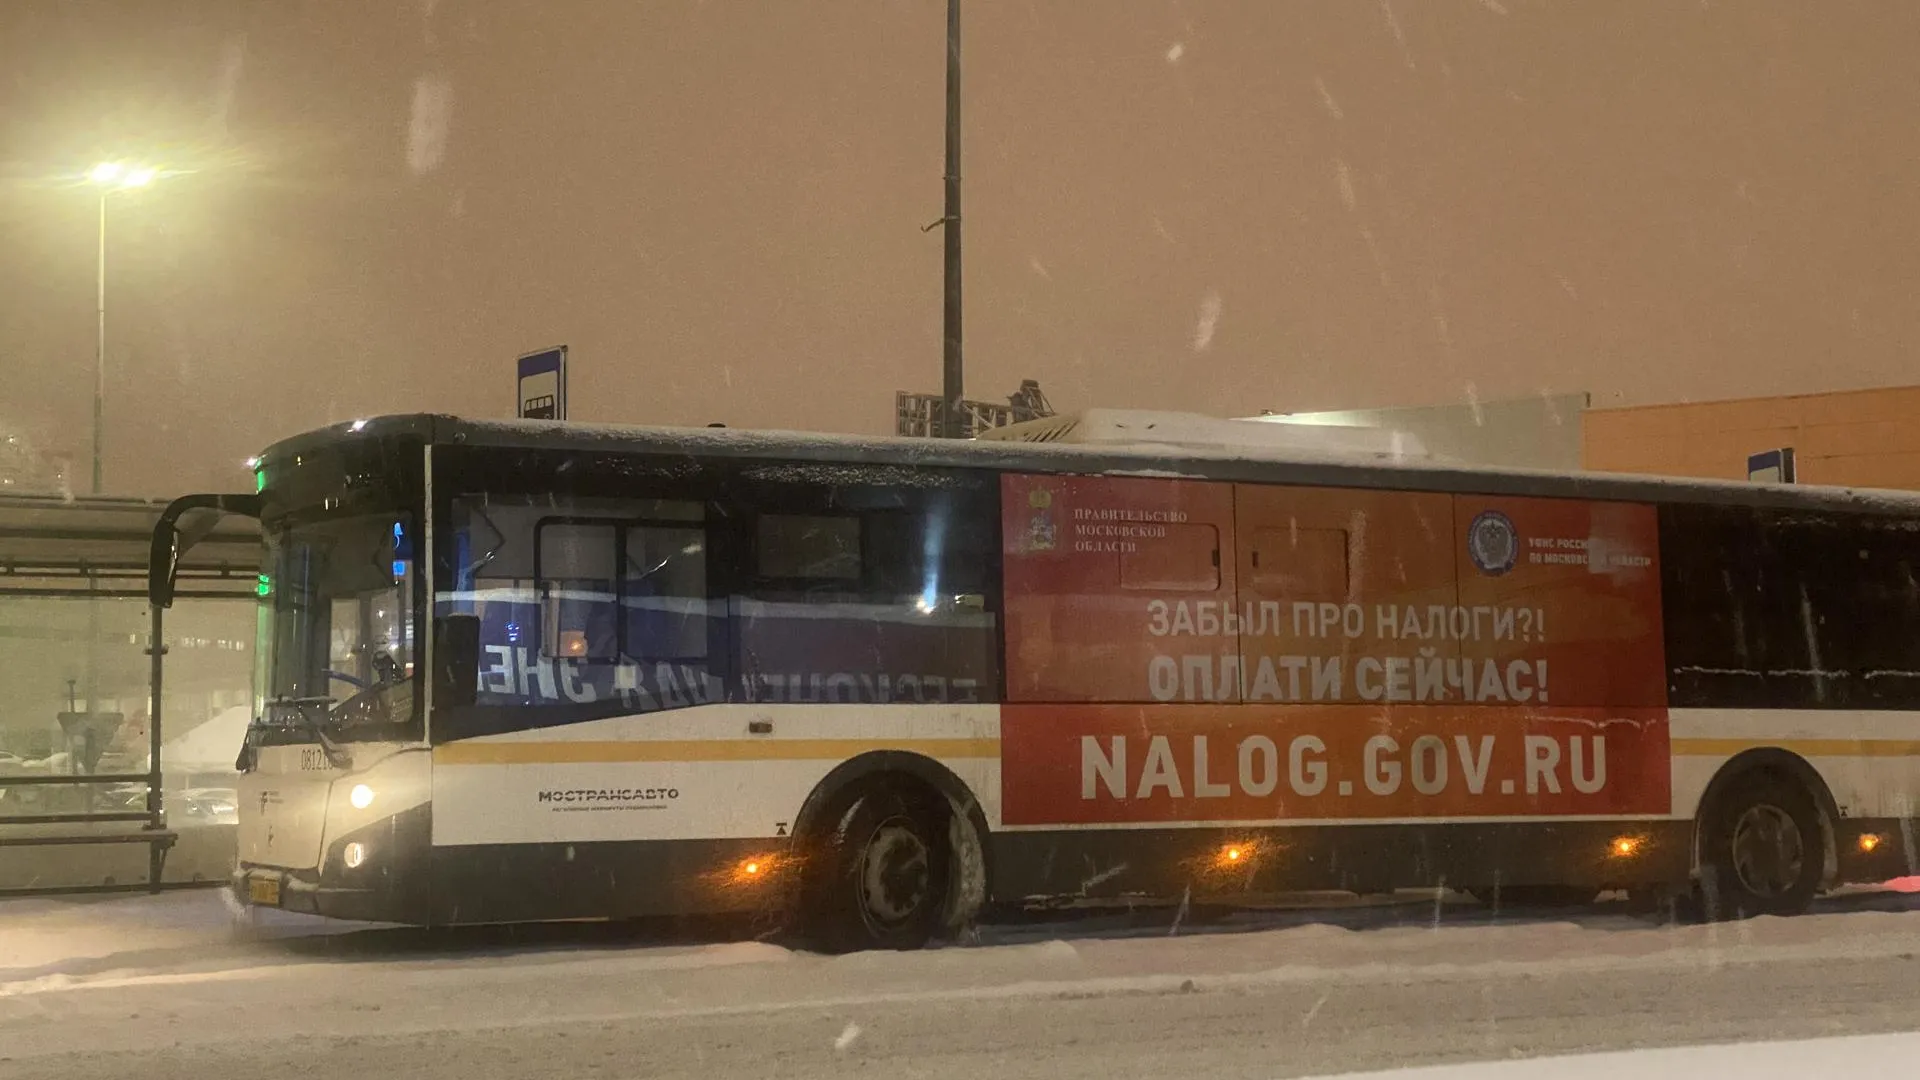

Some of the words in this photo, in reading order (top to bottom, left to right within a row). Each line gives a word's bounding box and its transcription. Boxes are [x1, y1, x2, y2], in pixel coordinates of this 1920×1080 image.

[1074, 508, 1187, 522] ПРАВИТЕЛЬСТВО
[1075, 524, 1165, 538] МОСКОВСКОЙ
[1075, 541, 1136, 552] ОБЛАСТИ
[1557, 538, 1594, 550] РОССИ
[1148, 599, 1279, 637] ЗАБЫЛ
[1293, 602, 1364, 638] ПРО
[1376, 604, 1545, 642] НАЛОГИ?!
[1149, 655, 1341, 701] ОПЛАТИ
[1355, 647, 1549, 702] СЕЙЧАС!
[1081, 734, 1607, 800] NALOG.GOV.RU
[538, 788, 679, 802] МОСТРАНСАВТО
